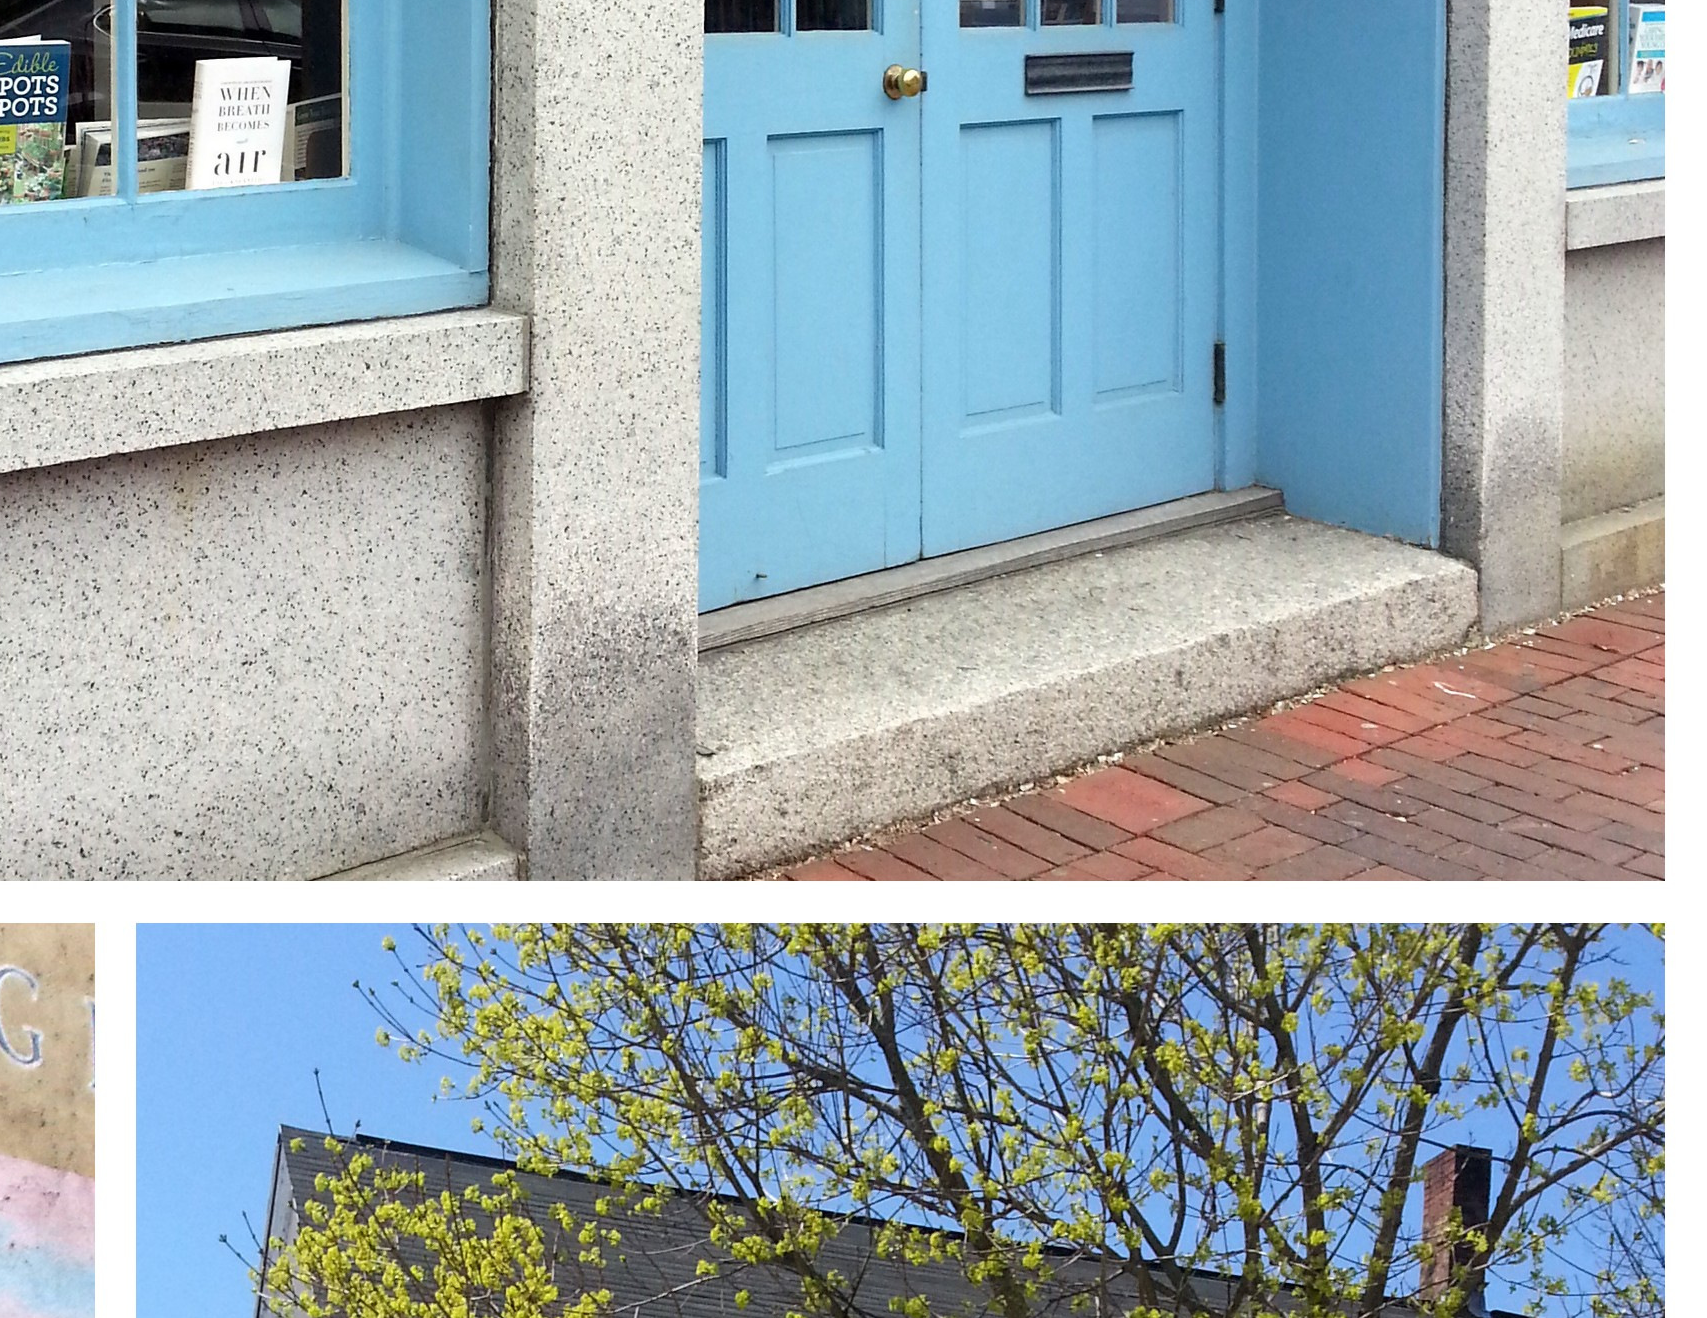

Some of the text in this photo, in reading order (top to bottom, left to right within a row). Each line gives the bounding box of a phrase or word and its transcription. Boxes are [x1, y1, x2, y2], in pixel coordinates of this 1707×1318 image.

[220, 86, 271, 101] WHEN
[218, 104, 270, 117] BREATH
[217, 120, 270, 132] BECOMES
[214, 150, 266, 175] air
